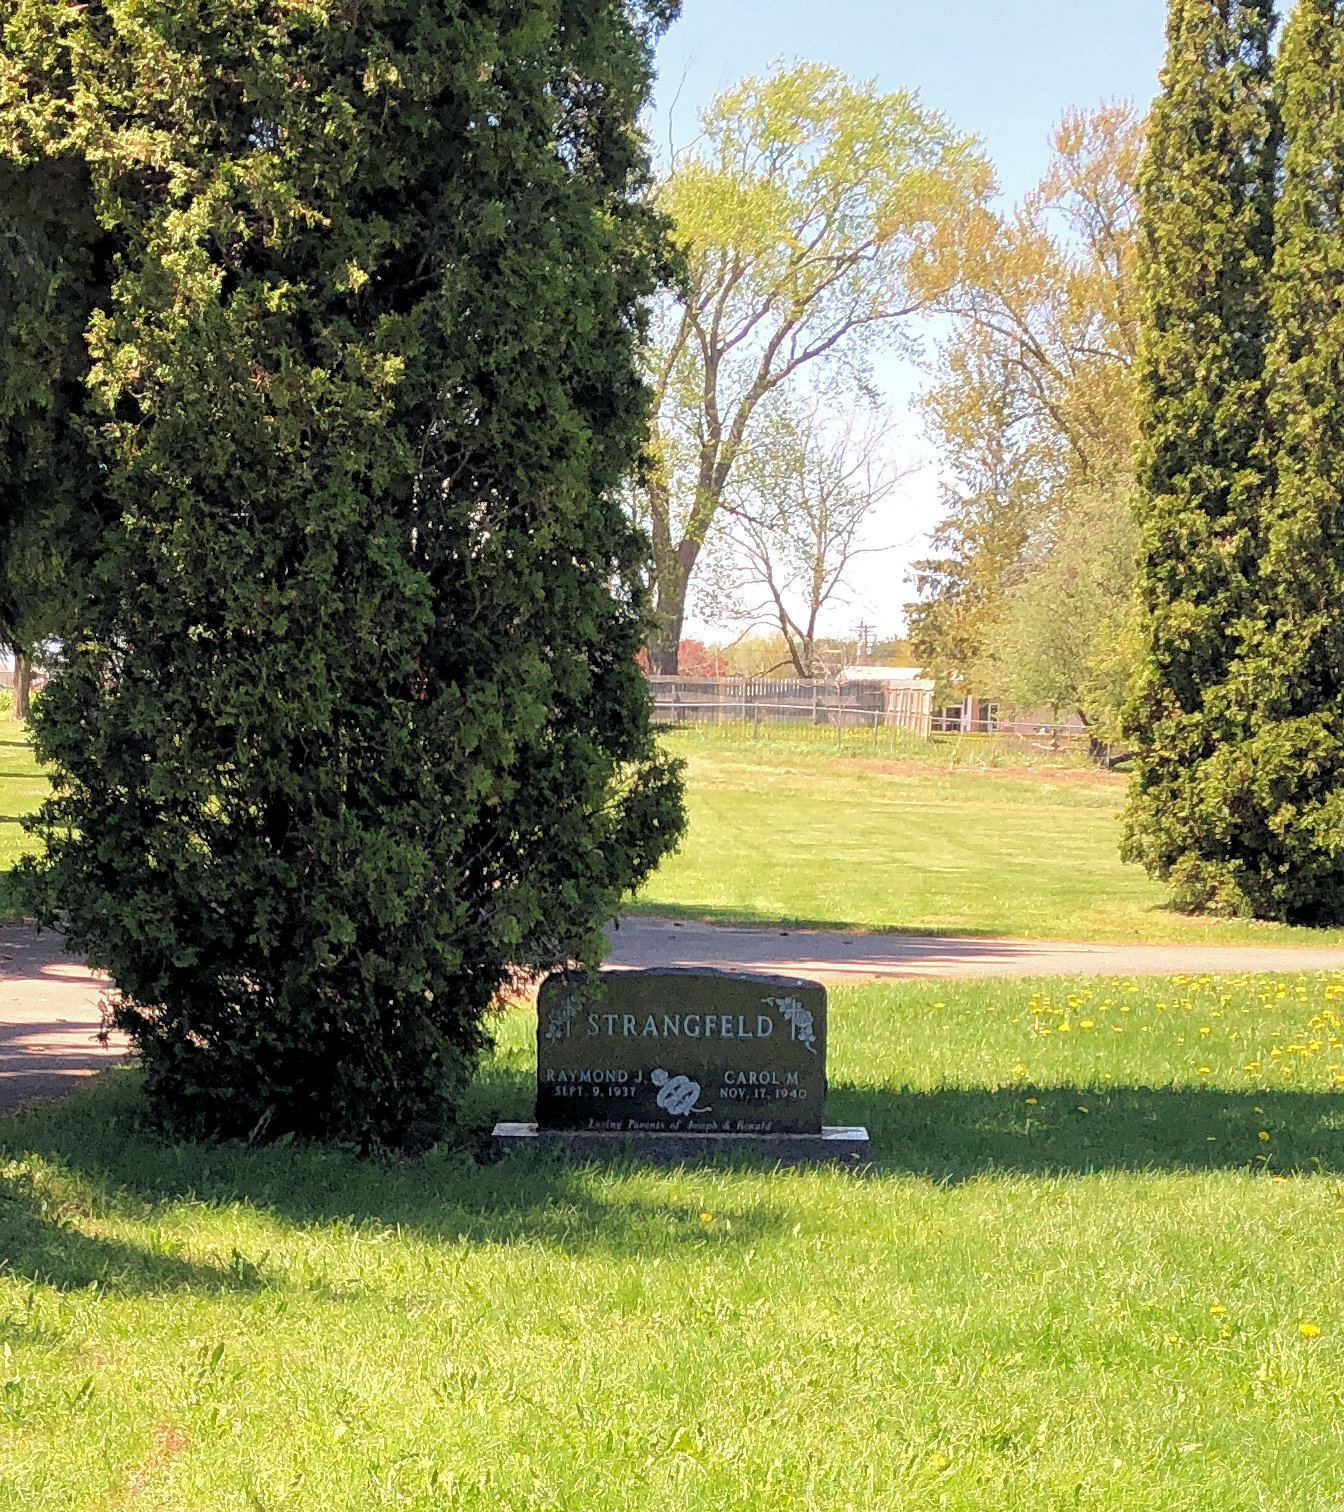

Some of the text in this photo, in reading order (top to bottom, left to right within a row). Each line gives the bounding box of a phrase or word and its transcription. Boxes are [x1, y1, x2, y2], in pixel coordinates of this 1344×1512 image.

[586, 1013, 775, 1038] STRANGFELD
[545, 1068, 629, 1083] RAYMOND
[724, 1070, 779, 1085] CAROL
[608, 1086, 637, 1097] 1937
[775, 1088, 807, 1099] 1940
